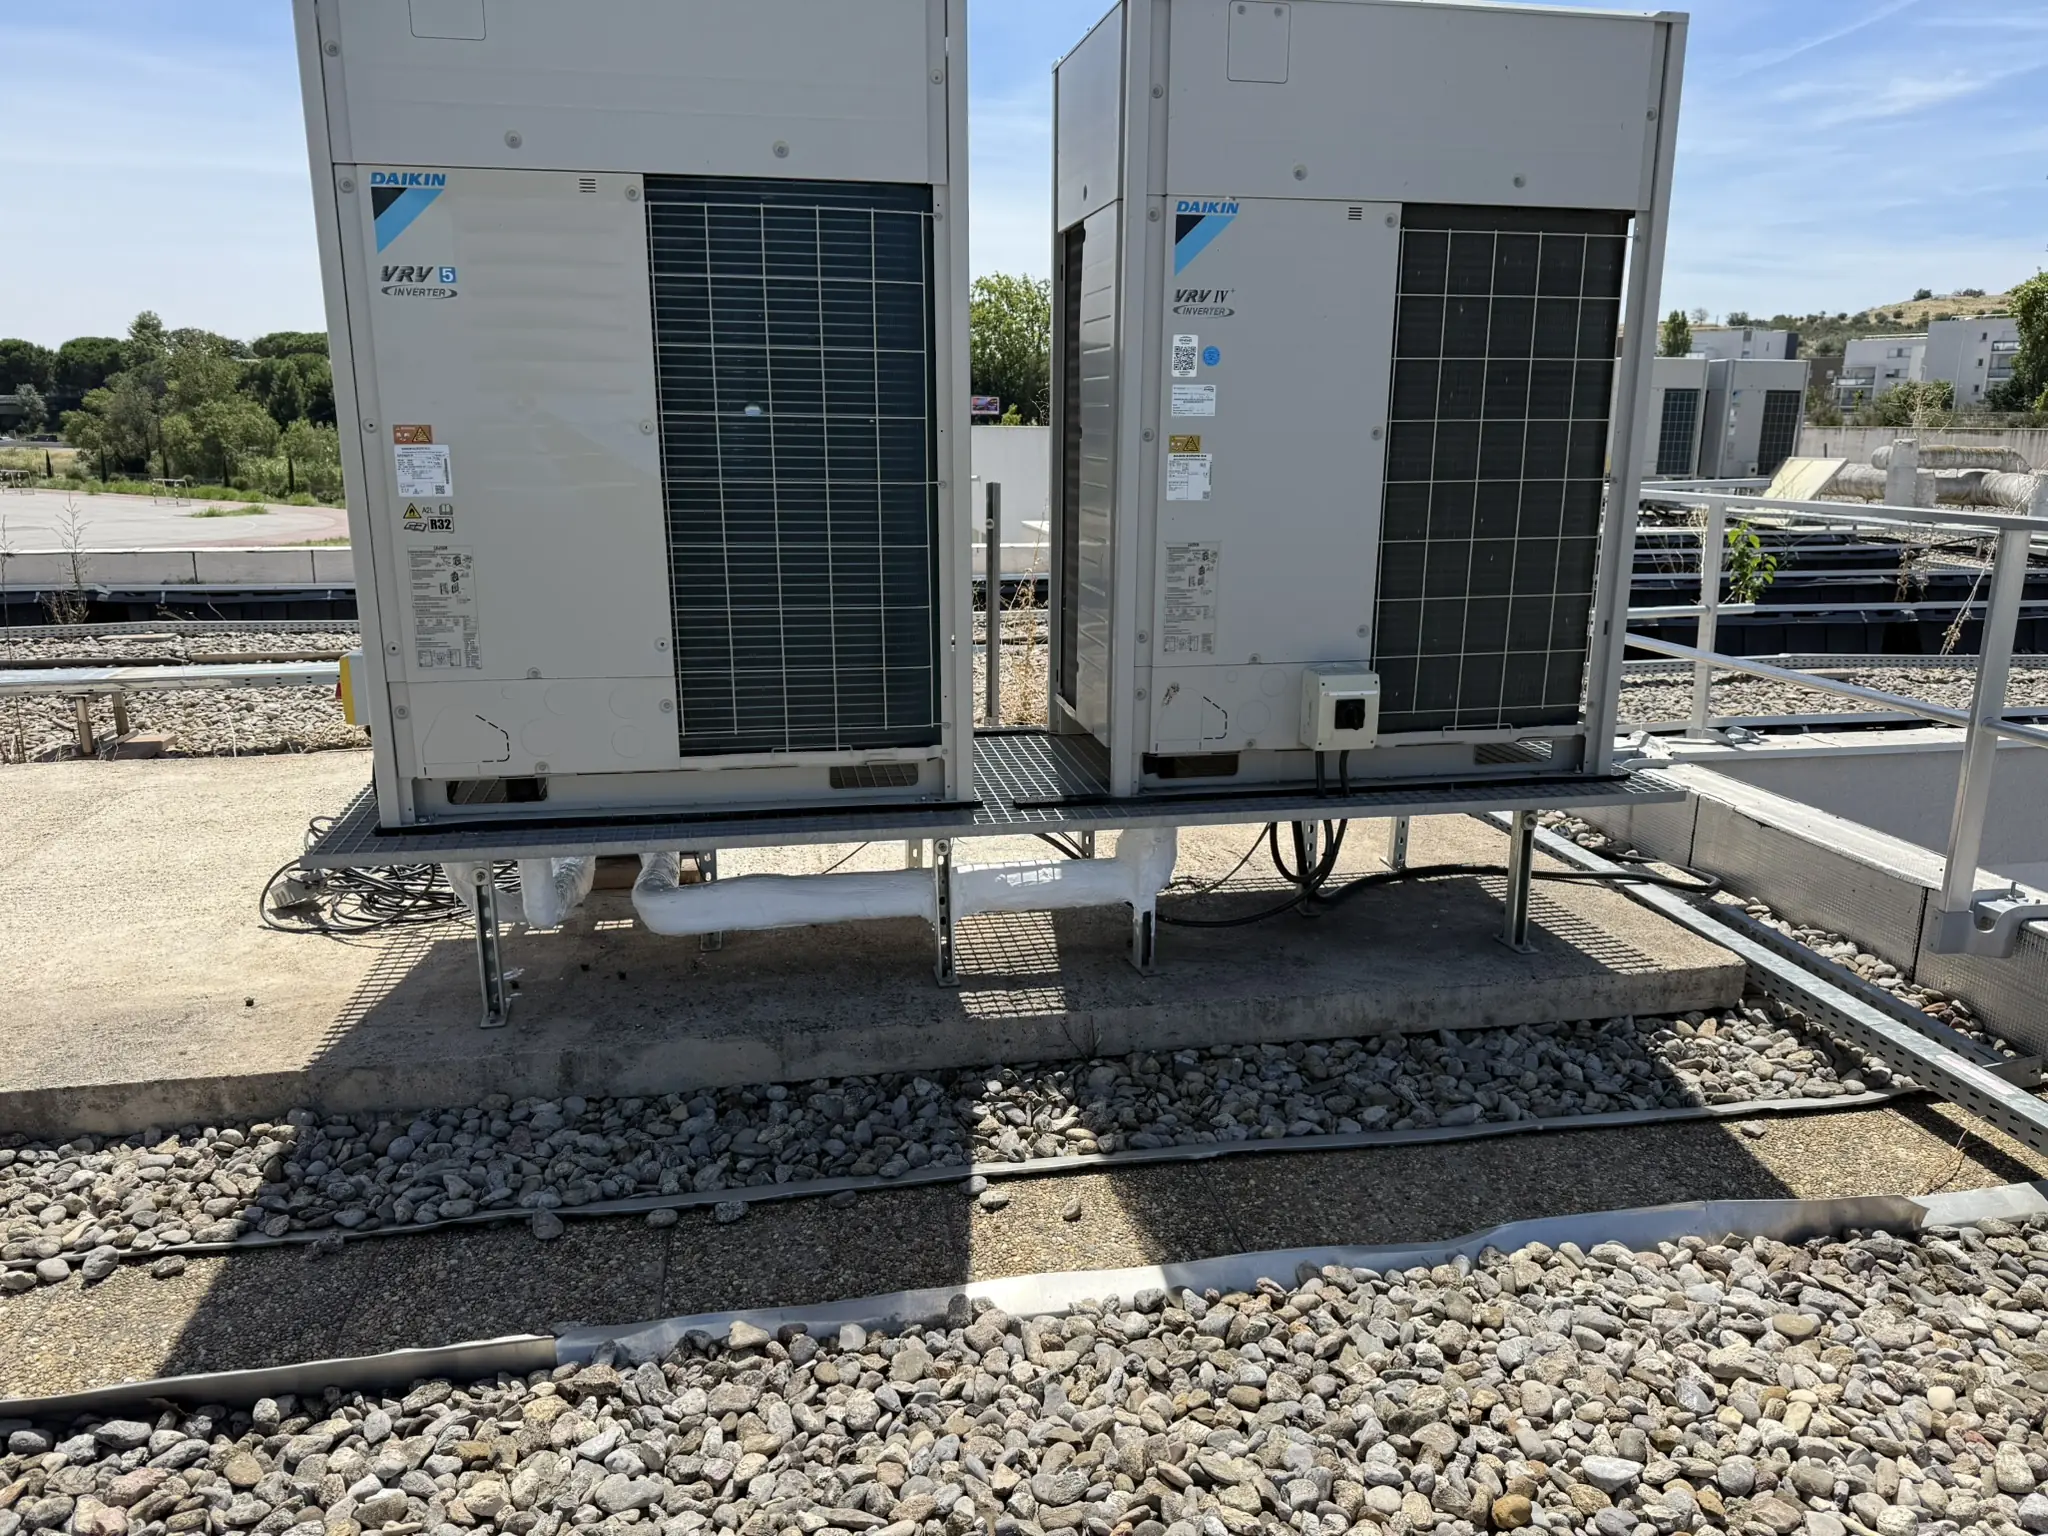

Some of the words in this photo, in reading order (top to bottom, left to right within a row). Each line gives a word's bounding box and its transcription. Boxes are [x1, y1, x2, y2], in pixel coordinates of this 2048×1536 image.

[370, 172, 446, 186] DAIKIN
[1176, 200, 1239, 214] DAIKIN
[381, 265, 434, 282] VRV
[443, 268, 454, 282] 5
[393, 286, 446, 297] INVERTER
[1174, 289, 1212, 303] VRV
[1183, 307, 1225, 316] INVERTER
[430, 519, 452, 530] R32
